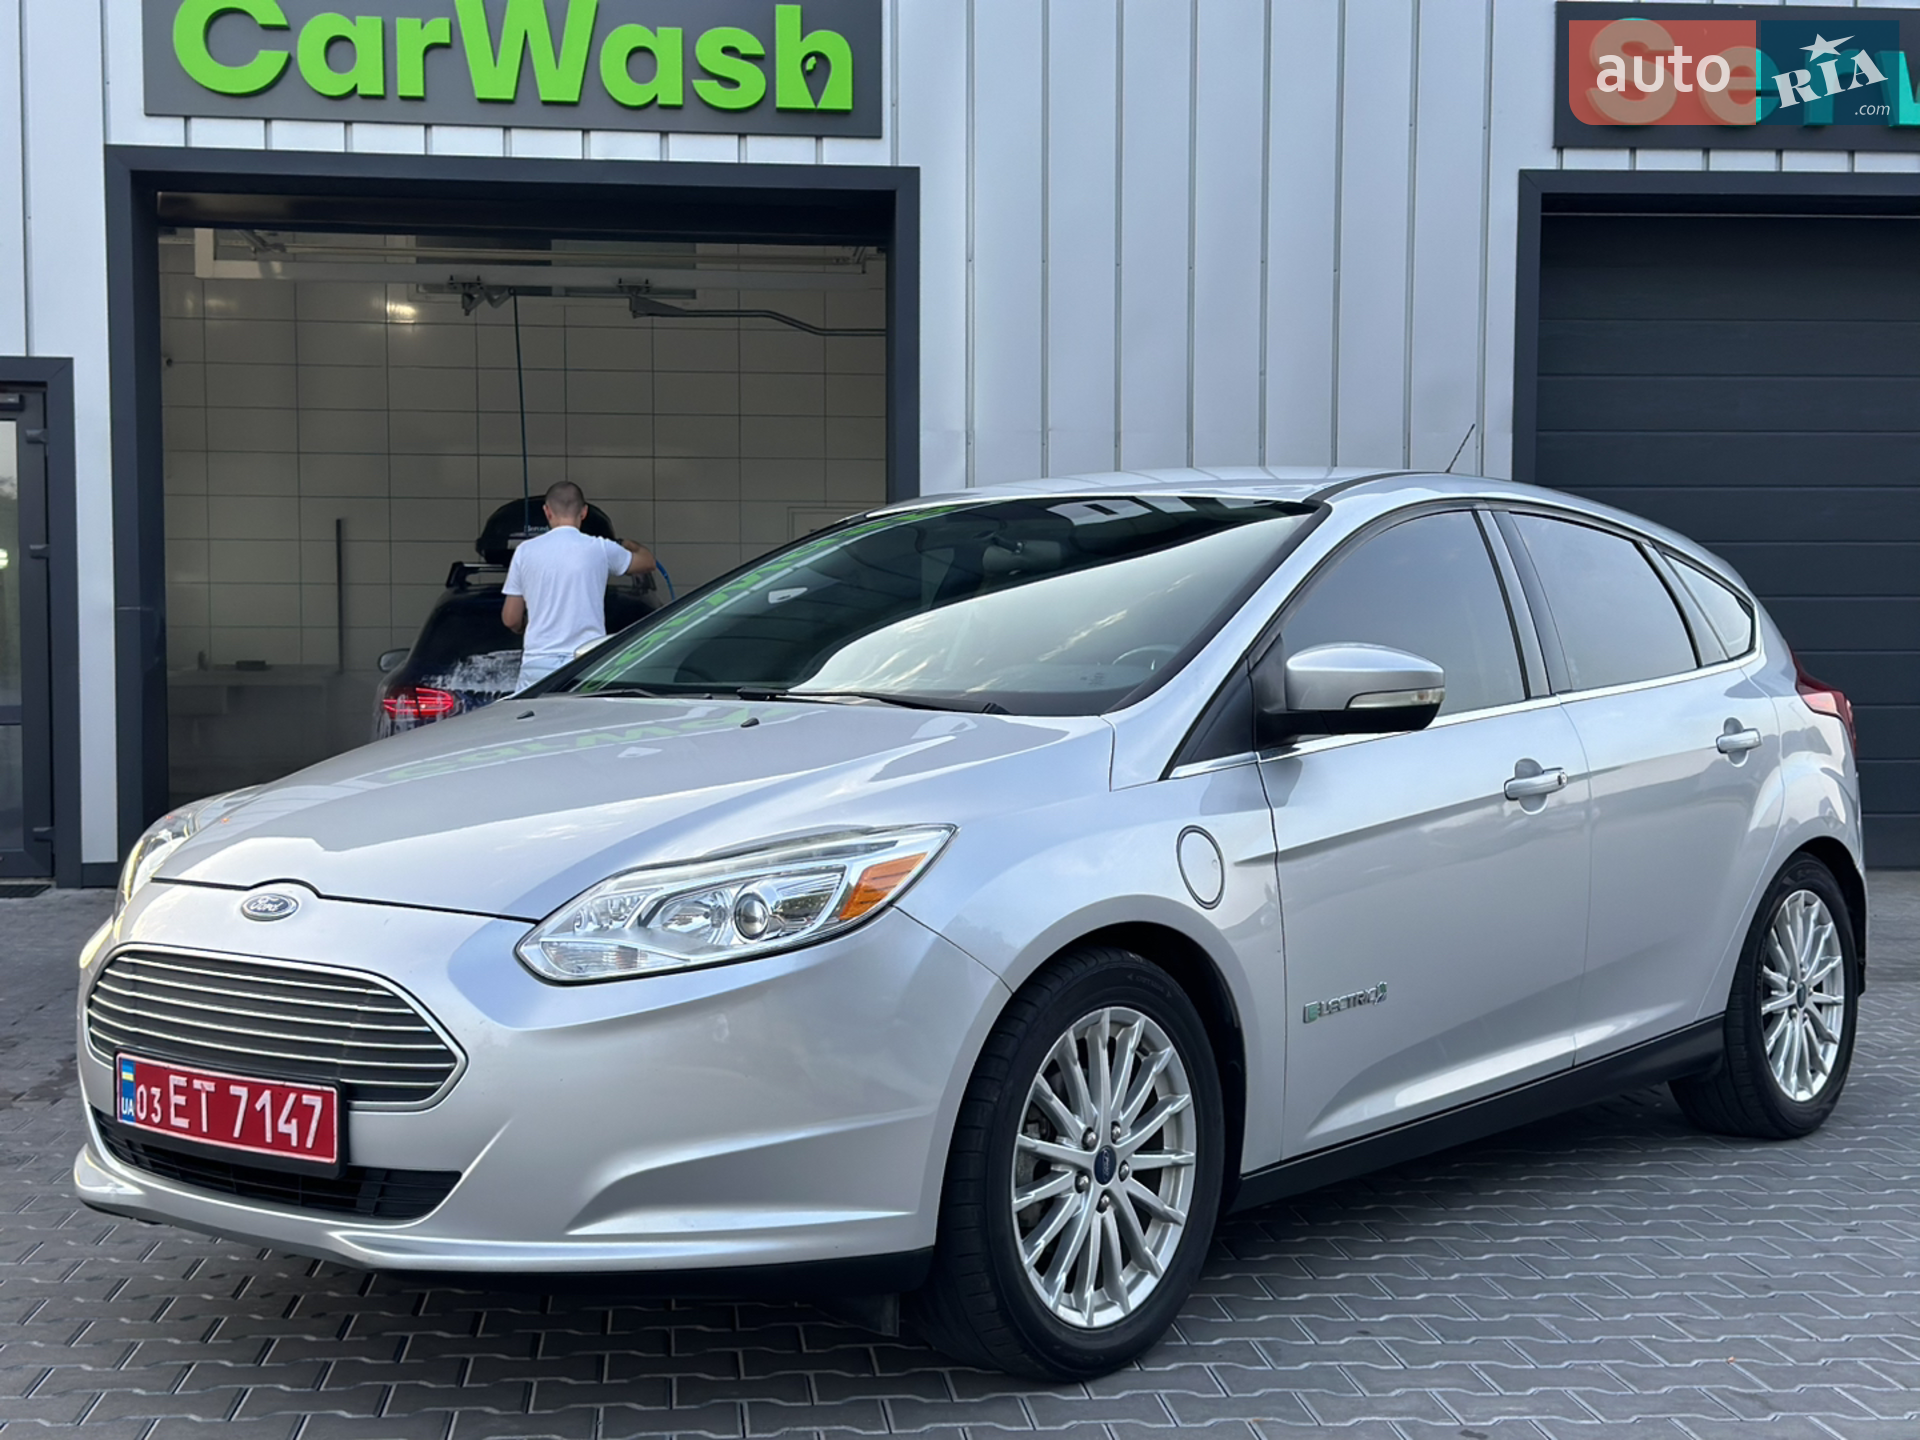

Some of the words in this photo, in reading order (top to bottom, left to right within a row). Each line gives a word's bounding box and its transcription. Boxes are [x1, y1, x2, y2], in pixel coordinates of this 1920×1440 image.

[173, 0, 853, 112] CarWash
[121, 1098, 134, 1117] UA
[229, 1084, 323, 1149] 7147
